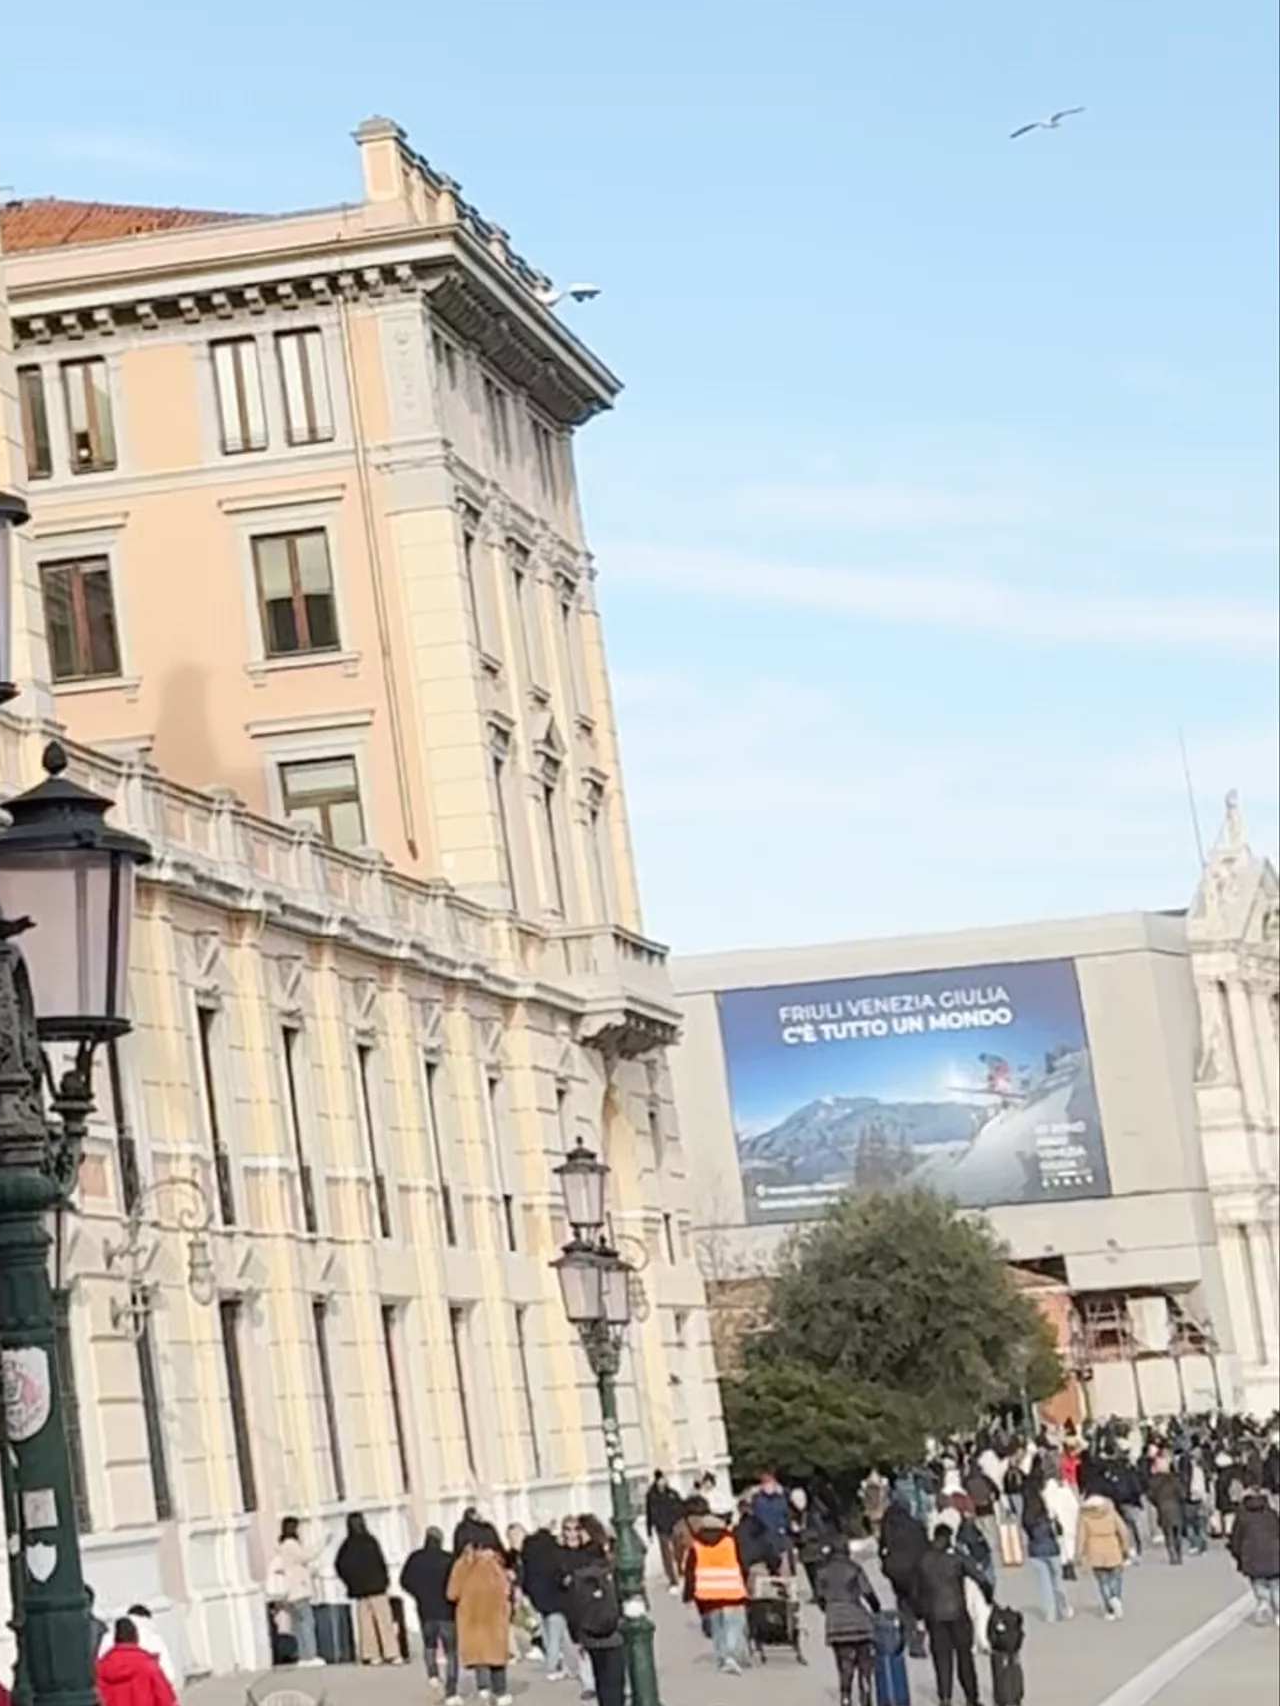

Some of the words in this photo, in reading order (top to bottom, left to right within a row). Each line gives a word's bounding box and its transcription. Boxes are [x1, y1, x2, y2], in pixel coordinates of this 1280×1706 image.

[779, 1005, 843, 1023] FRIULI
[847, 994, 935, 1016] VENEZIA
[939, 986, 1010, 1008] GIULIA
[782, 1025, 818, 1044] C'È
[820, 1020, 888, 1041] TUTTO
[893, 1015, 924, 1034] UN
[929, 1007, 1013, 1031] MONDO
